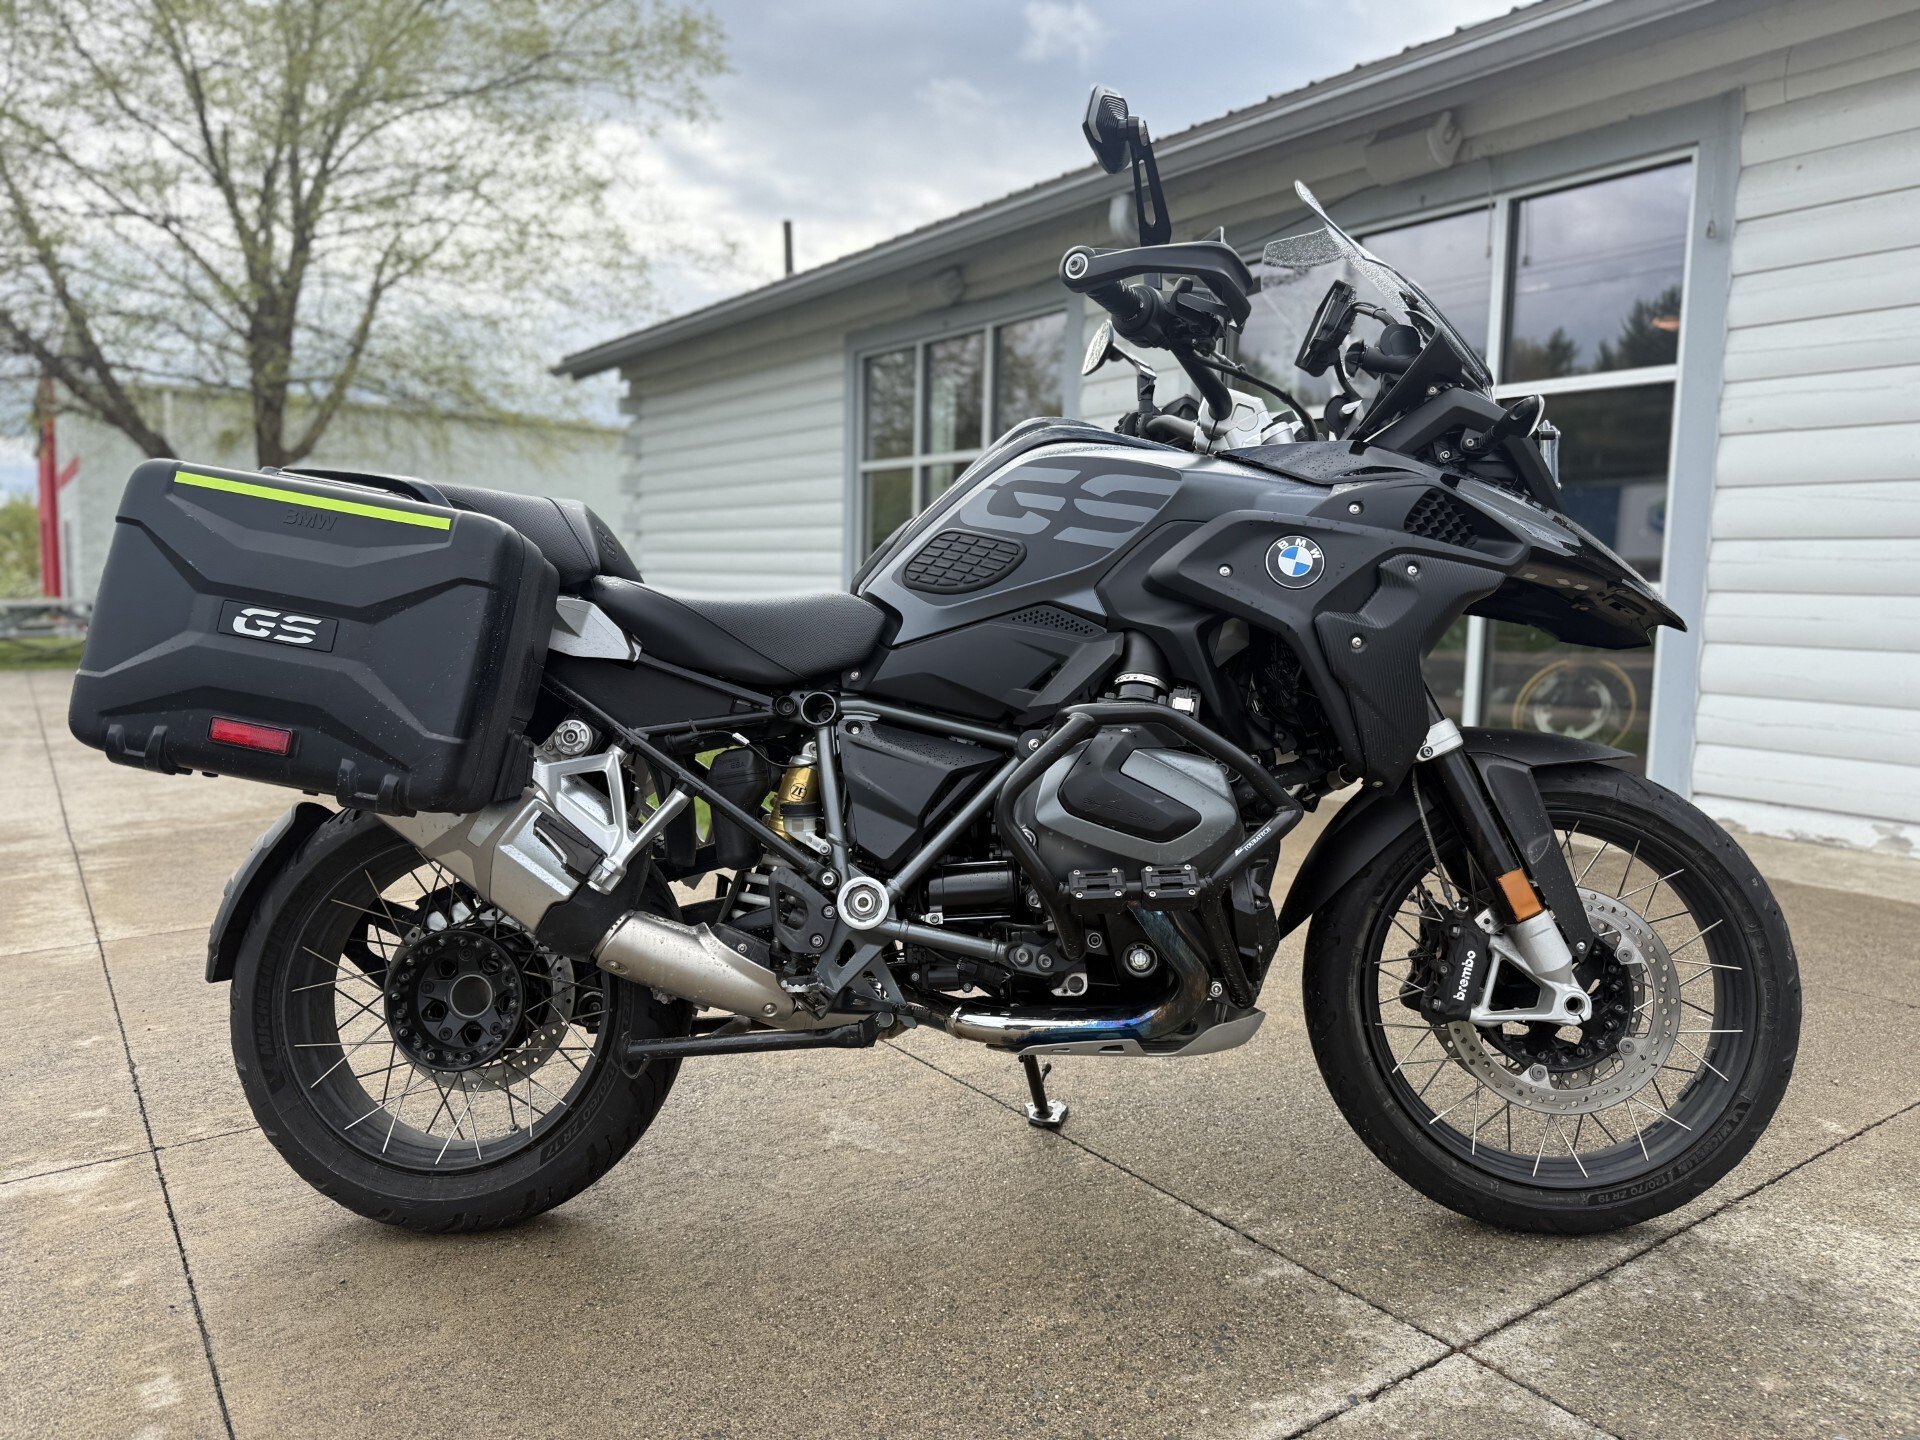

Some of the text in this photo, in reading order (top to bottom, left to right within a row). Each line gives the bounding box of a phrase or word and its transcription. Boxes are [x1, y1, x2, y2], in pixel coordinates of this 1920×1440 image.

[282, 508, 338, 531] BMW
[960, 466, 1183, 549] GS
[1277, 538, 1321, 559] BMW
[232, 607, 322, 644] GS
[1243, 826, 1272, 851] TOURATECH
[1453, 950, 1476, 1001] brembo
[1678, 1118, 1735, 1174] MICHELIN
[1630, 1172, 1667, 1196] 120/70
